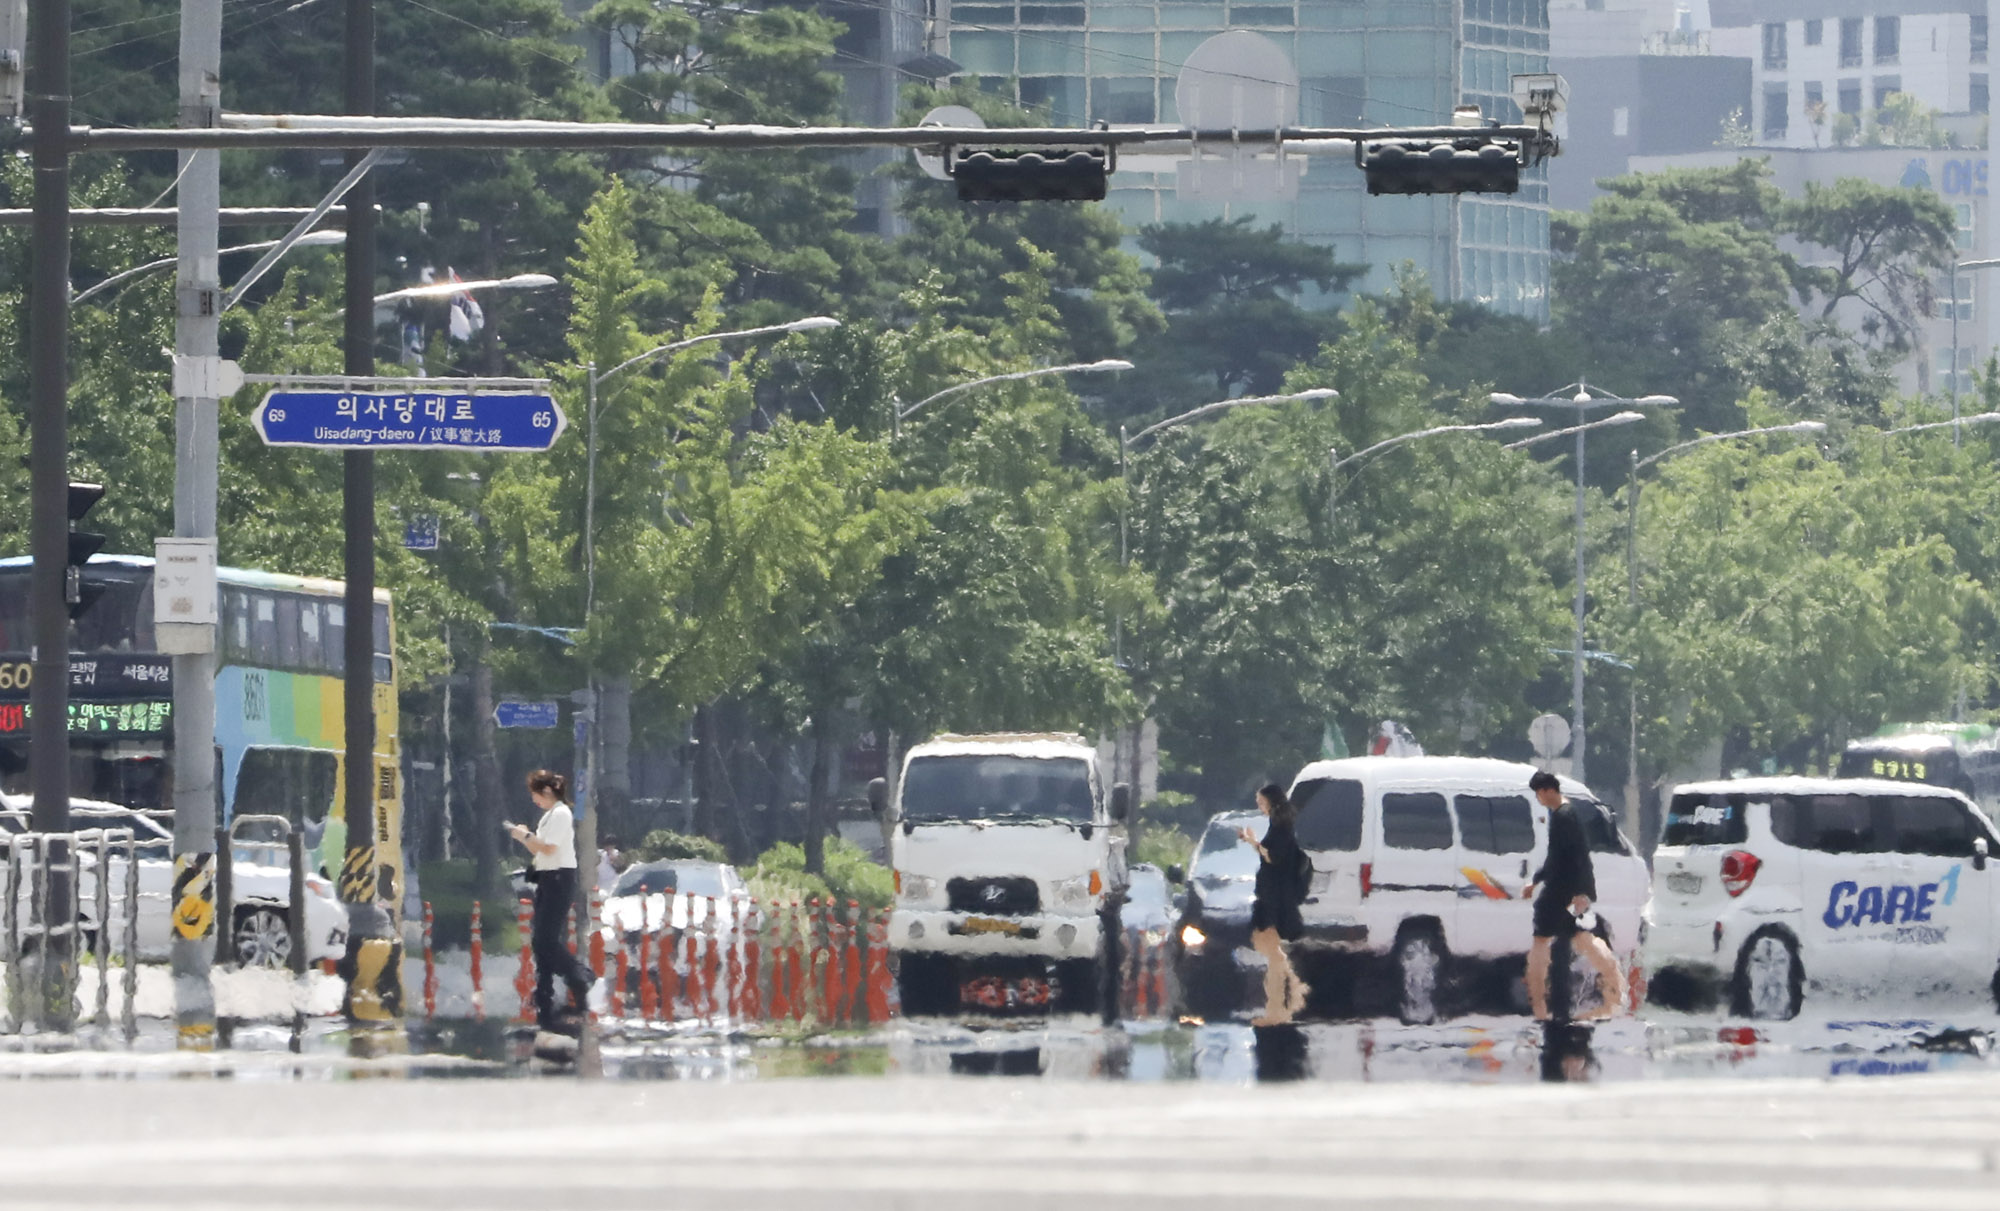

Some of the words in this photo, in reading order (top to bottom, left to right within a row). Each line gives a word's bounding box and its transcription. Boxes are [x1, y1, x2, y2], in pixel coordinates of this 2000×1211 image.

[268, 409, 286, 422] 69
[336, 395, 475, 424] 의사당대로
[532, 411, 551, 428] 65
[314, 426, 415, 442] Uisadang-daero
